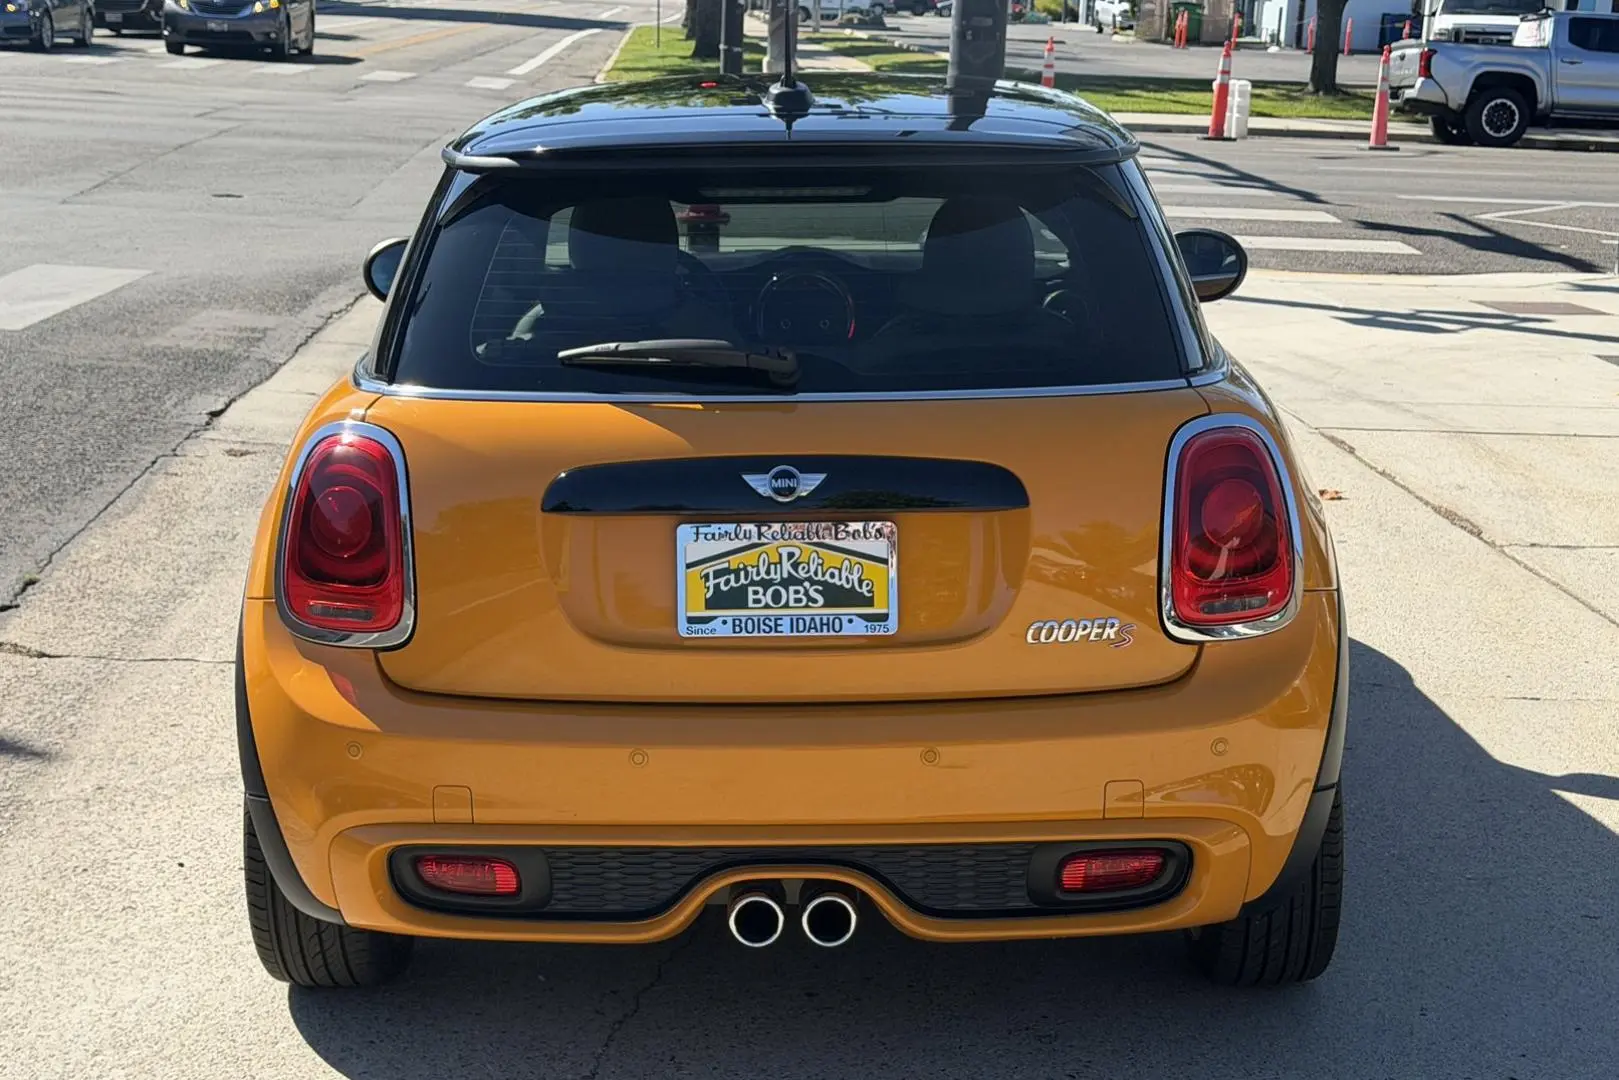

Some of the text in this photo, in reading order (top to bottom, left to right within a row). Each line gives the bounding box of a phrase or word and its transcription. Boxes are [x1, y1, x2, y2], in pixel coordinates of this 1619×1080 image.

[771, 478, 798, 488] MINI
[690, 524, 752, 542] Fairly
[754, 523, 834, 541] Reliable
[701, 546, 873, 599] Fairly Reliable
[748, 580, 824, 608] BOB'S
[686, 617, 890, 636] Since BOISE IDAHO 1975
[1025, 617, 1121, 644] COOPER
